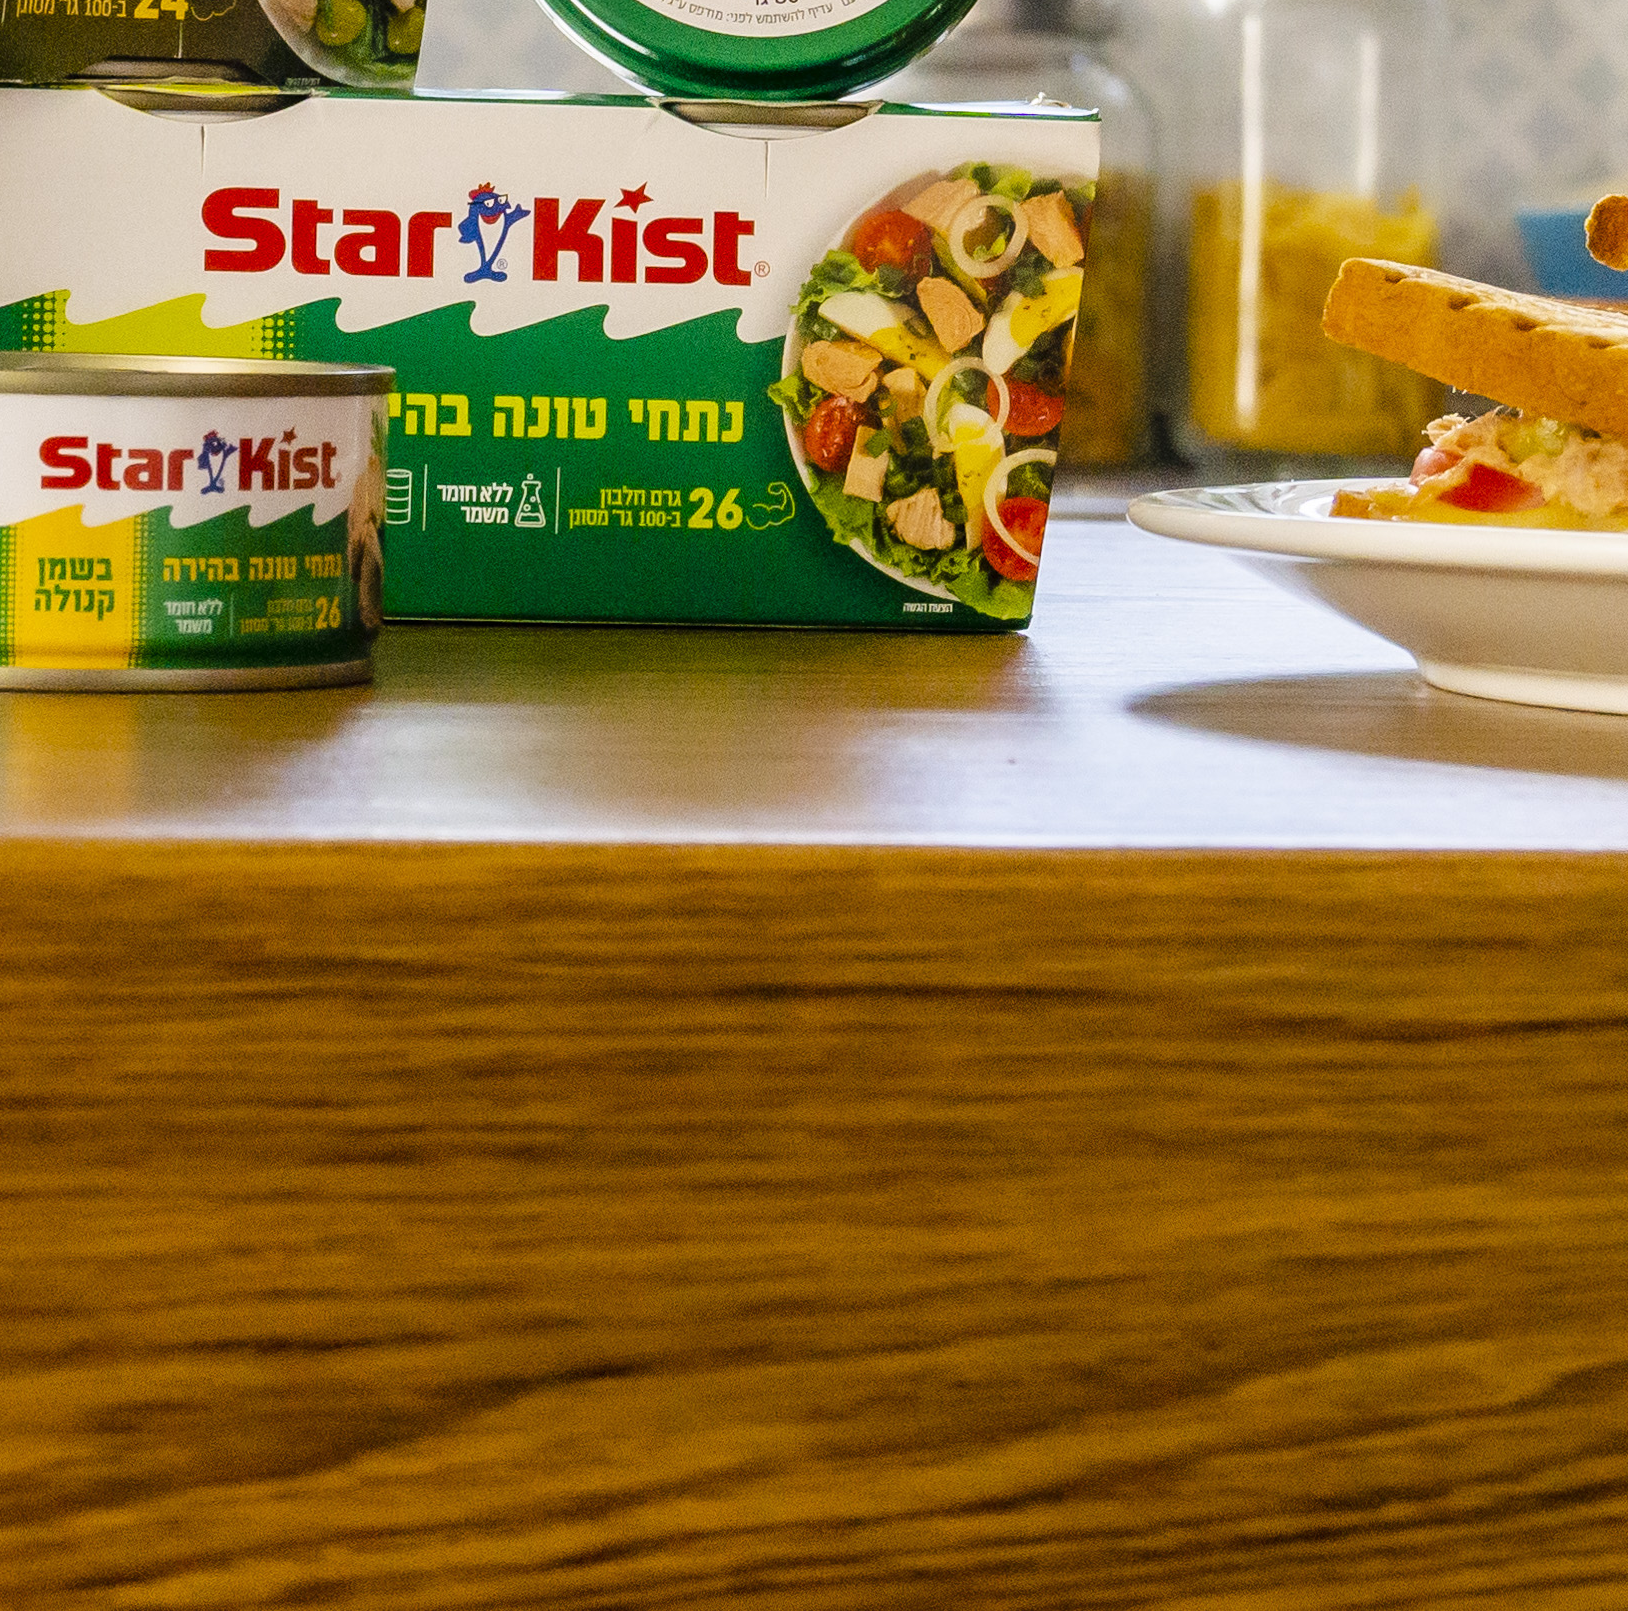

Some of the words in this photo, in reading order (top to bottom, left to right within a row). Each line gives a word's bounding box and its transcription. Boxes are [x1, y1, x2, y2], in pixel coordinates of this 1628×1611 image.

[689, 3, 723, 20] מודפס
[756, 9, 805, 25] להשתמש
[808, 4, 833, 19] עדיף
[493, 395, 606, 439] טונה
[629, 399, 744, 442] נתחי
[437, 484, 476, 502] חומר
[480, 482, 513, 502] ללא
[601, 486, 646, 509] חלבון
[651, 489, 681, 506] גרם
[461, 507, 509, 524] משמר
[569, 509, 609, 529] מסונן
[639, 510, 681, 527] ב-100
[687, 487, 743, 530] 26
[38, 557, 112, 587] בשמן
[163, 556, 239, 582] בהירה
[249, 556, 296, 581] טונה
[305, 554, 341, 578] נתחי
[34, 584, 114, 621] קנולה
[315, 596, 340, 630] 26
[175, 619, 212, 634] משמר
